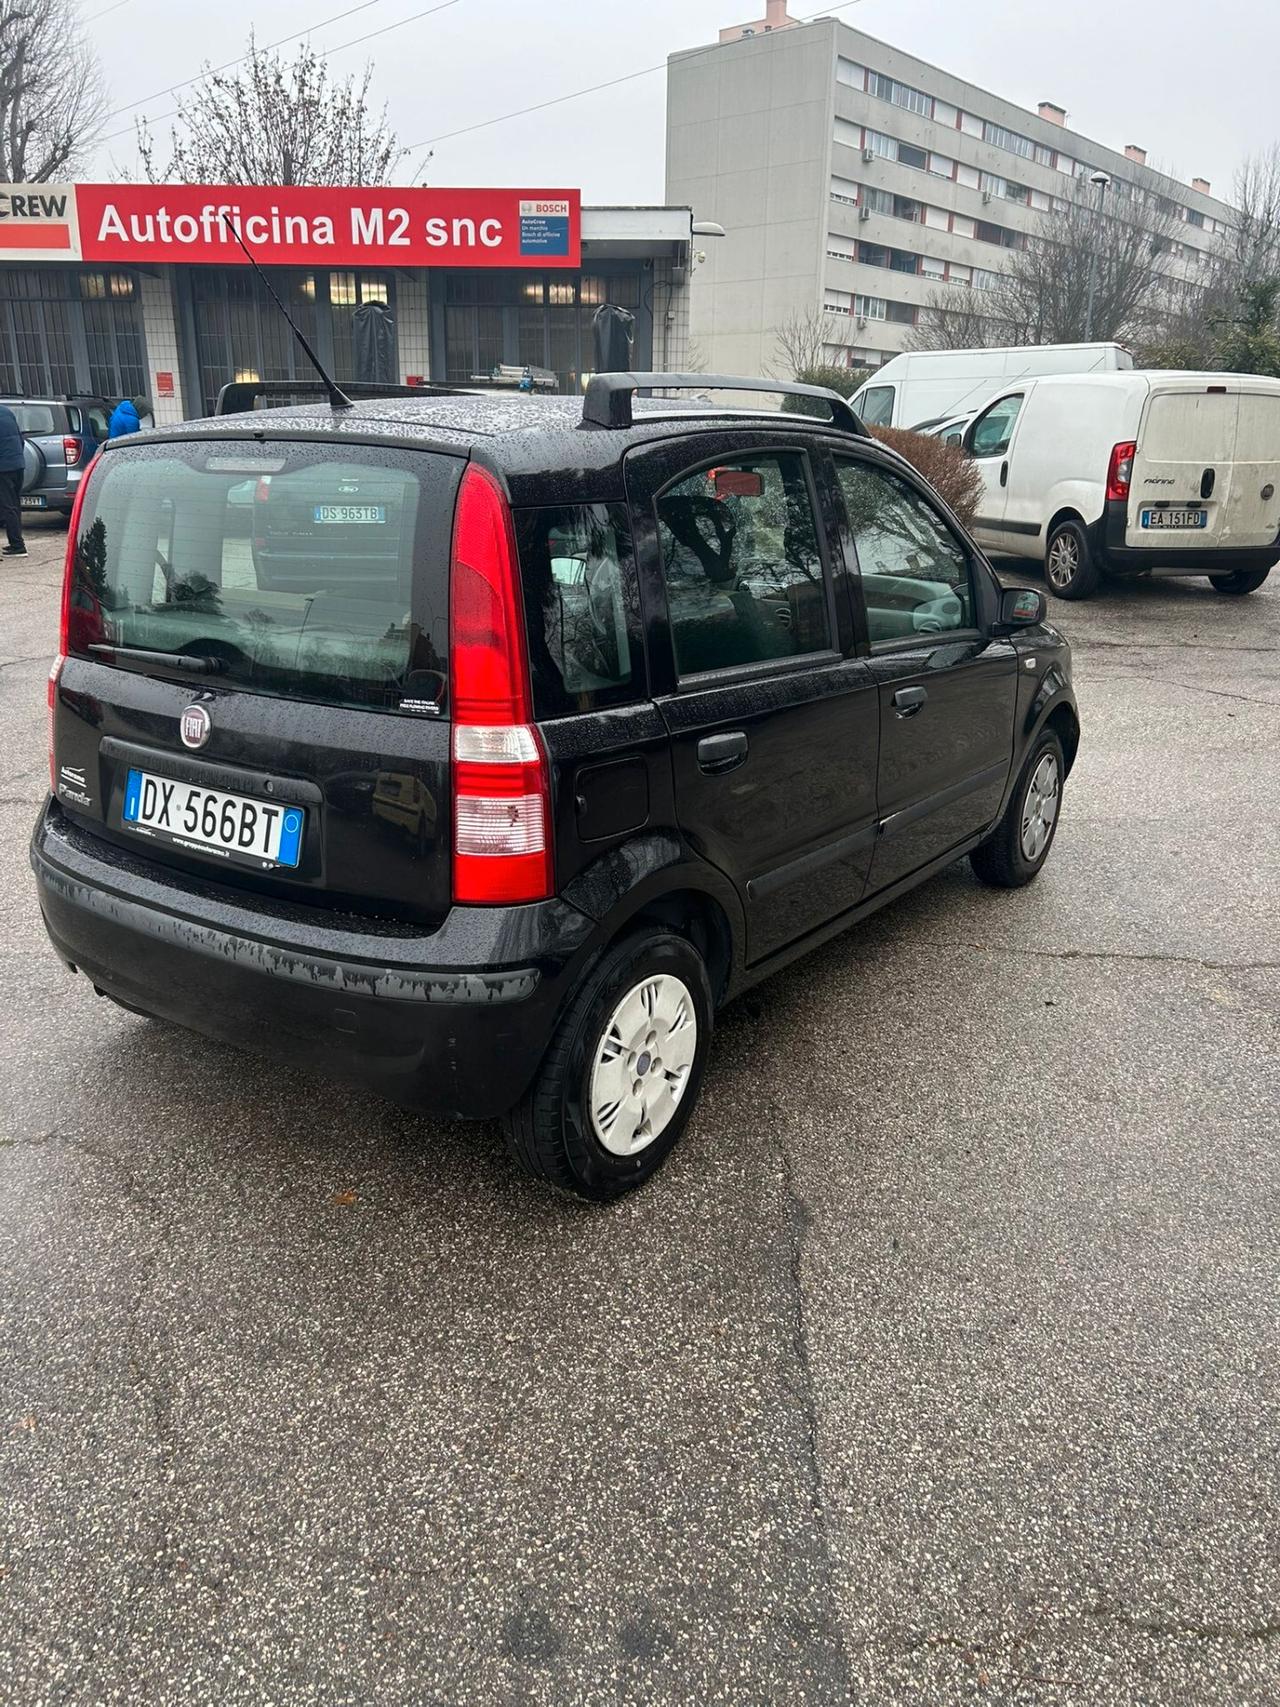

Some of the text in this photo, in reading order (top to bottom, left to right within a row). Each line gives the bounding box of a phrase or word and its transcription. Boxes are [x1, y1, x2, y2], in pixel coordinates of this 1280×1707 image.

[536, 204, 567, 213] BOSCH
[97, 204, 503, 247] Autofficina M2 snc
[322, 507, 337, 520] DS
[342, 508, 377, 519] 963TB
[1151, 512, 1164, 524] EA
[1169, 512, 1200, 524] 151FD
[185, 716, 204, 738] FIAT
[59, 783, 92, 806] Panda
[141, 778, 176, 828] DX
[183, 789, 280, 854] 566BT
